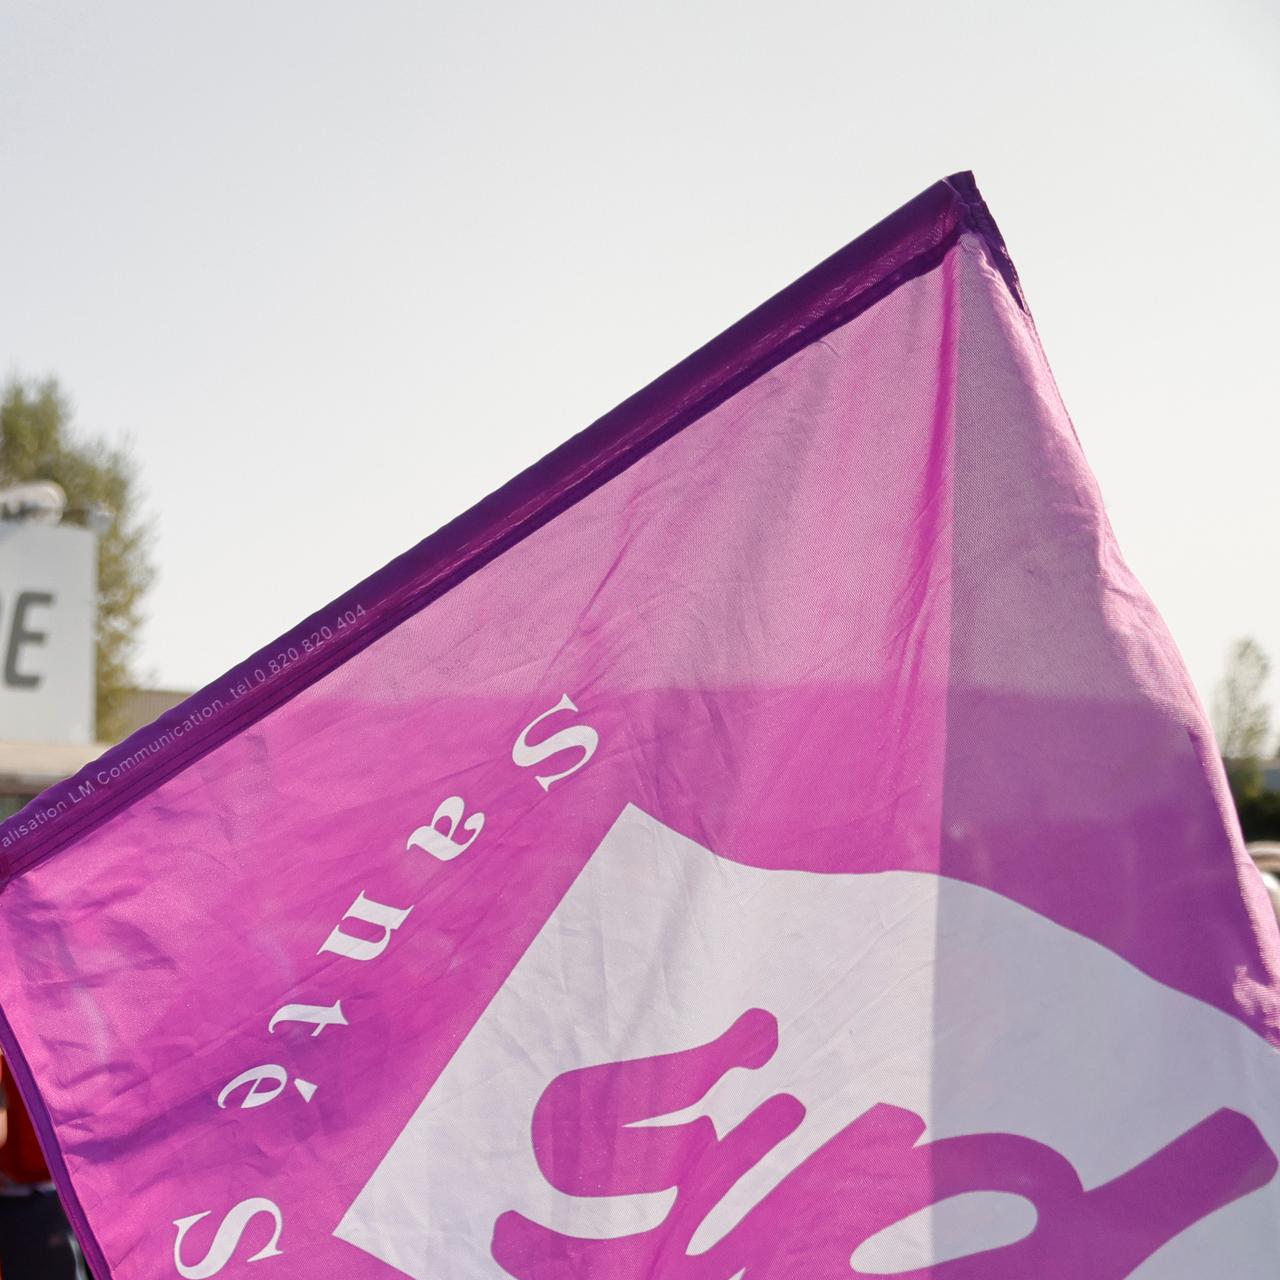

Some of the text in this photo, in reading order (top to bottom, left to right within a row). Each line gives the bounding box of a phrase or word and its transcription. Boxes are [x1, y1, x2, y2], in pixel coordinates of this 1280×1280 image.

[69, 780, 96, 804] LM
[254, 668, 266, 683] 0
[268, 647, 300, 675] 820
[301, 625, 333, 653] 820
[336, 603, 366, 630] 404
